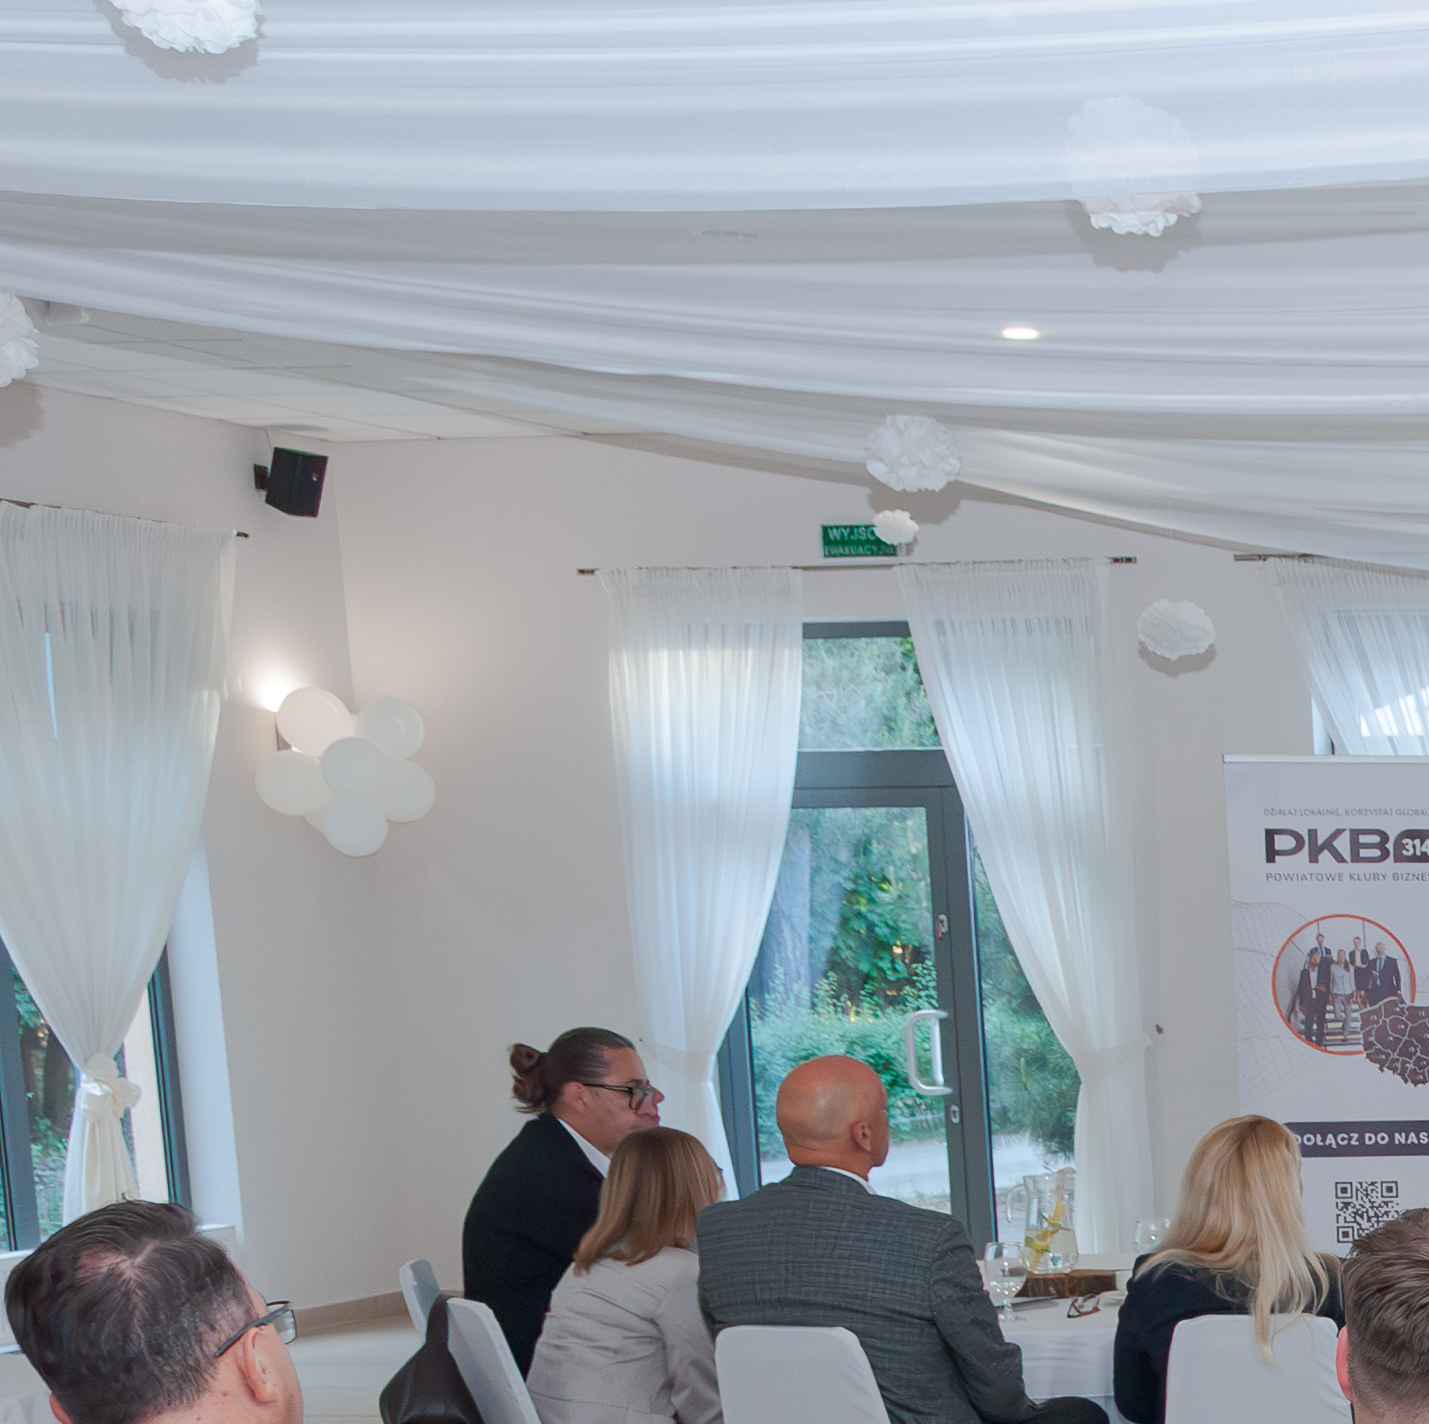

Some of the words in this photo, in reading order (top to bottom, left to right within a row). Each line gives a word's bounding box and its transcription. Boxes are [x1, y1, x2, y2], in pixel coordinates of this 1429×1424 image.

[1345, 808, 1393, 817] KORZYSTAJ
[1264, 828, 1391, 863] PKB
[1266, 872, 1344, 882] POWIATOWE
[1350, 872, 1387, 882] KLUBY
[1365, 1132, 1389, 1145] DO
